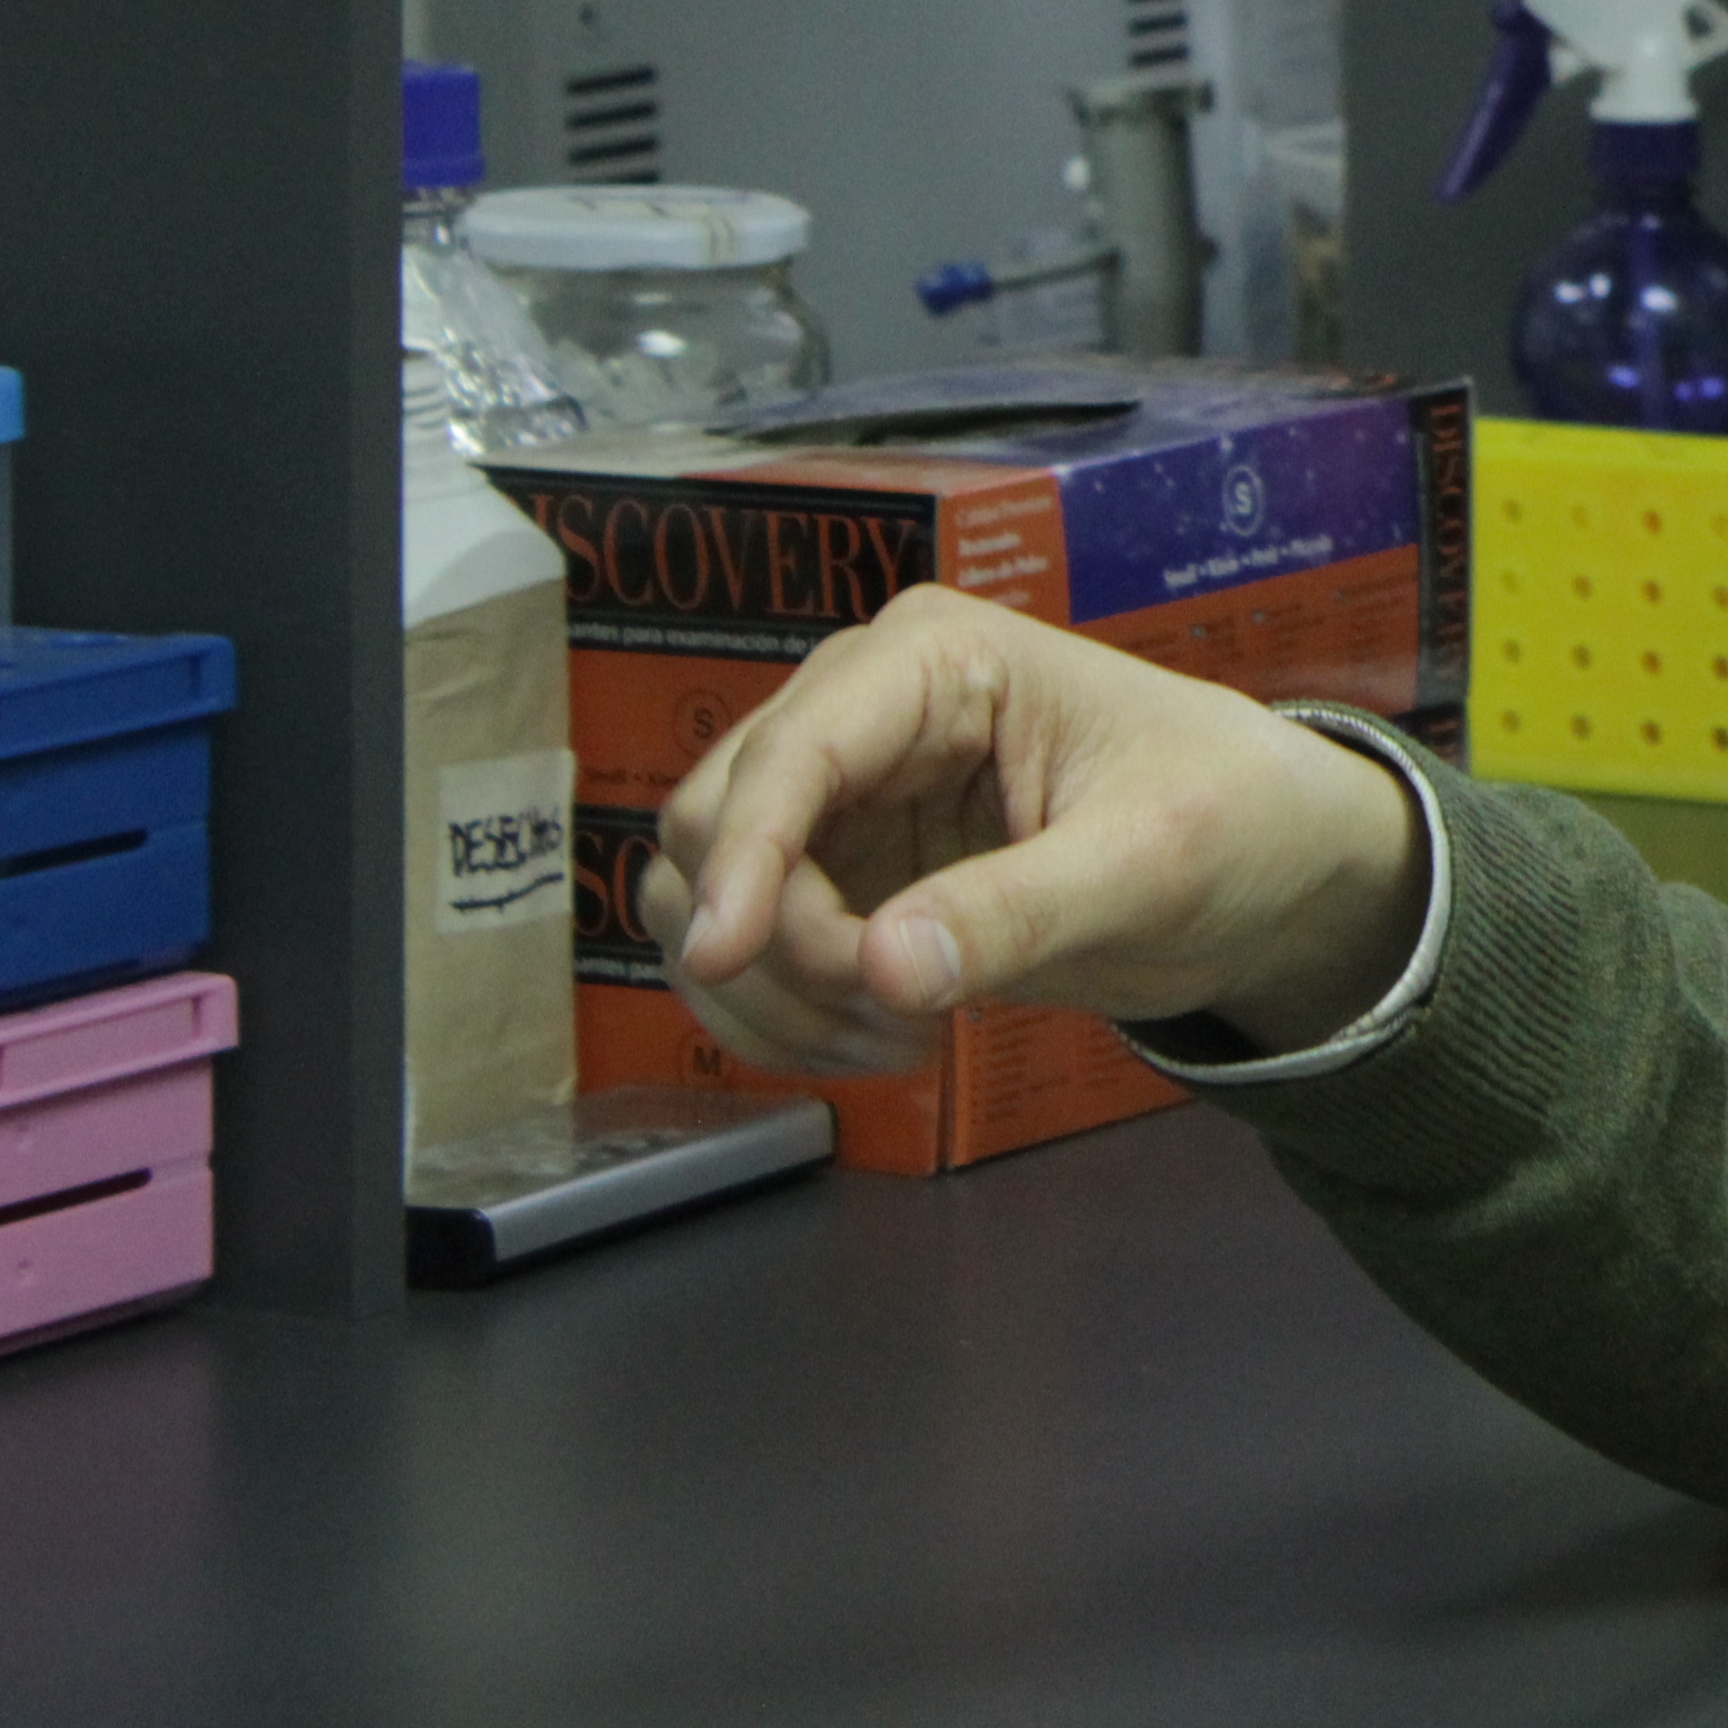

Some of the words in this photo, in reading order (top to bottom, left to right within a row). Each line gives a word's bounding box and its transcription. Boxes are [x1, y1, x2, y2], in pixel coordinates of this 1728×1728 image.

[1235, 481, 1251, 514] S
[510, 491, 918, 624] SCOVERY
[693, 708, 715, 739] S
[693, 1045, 721, 1076] M
